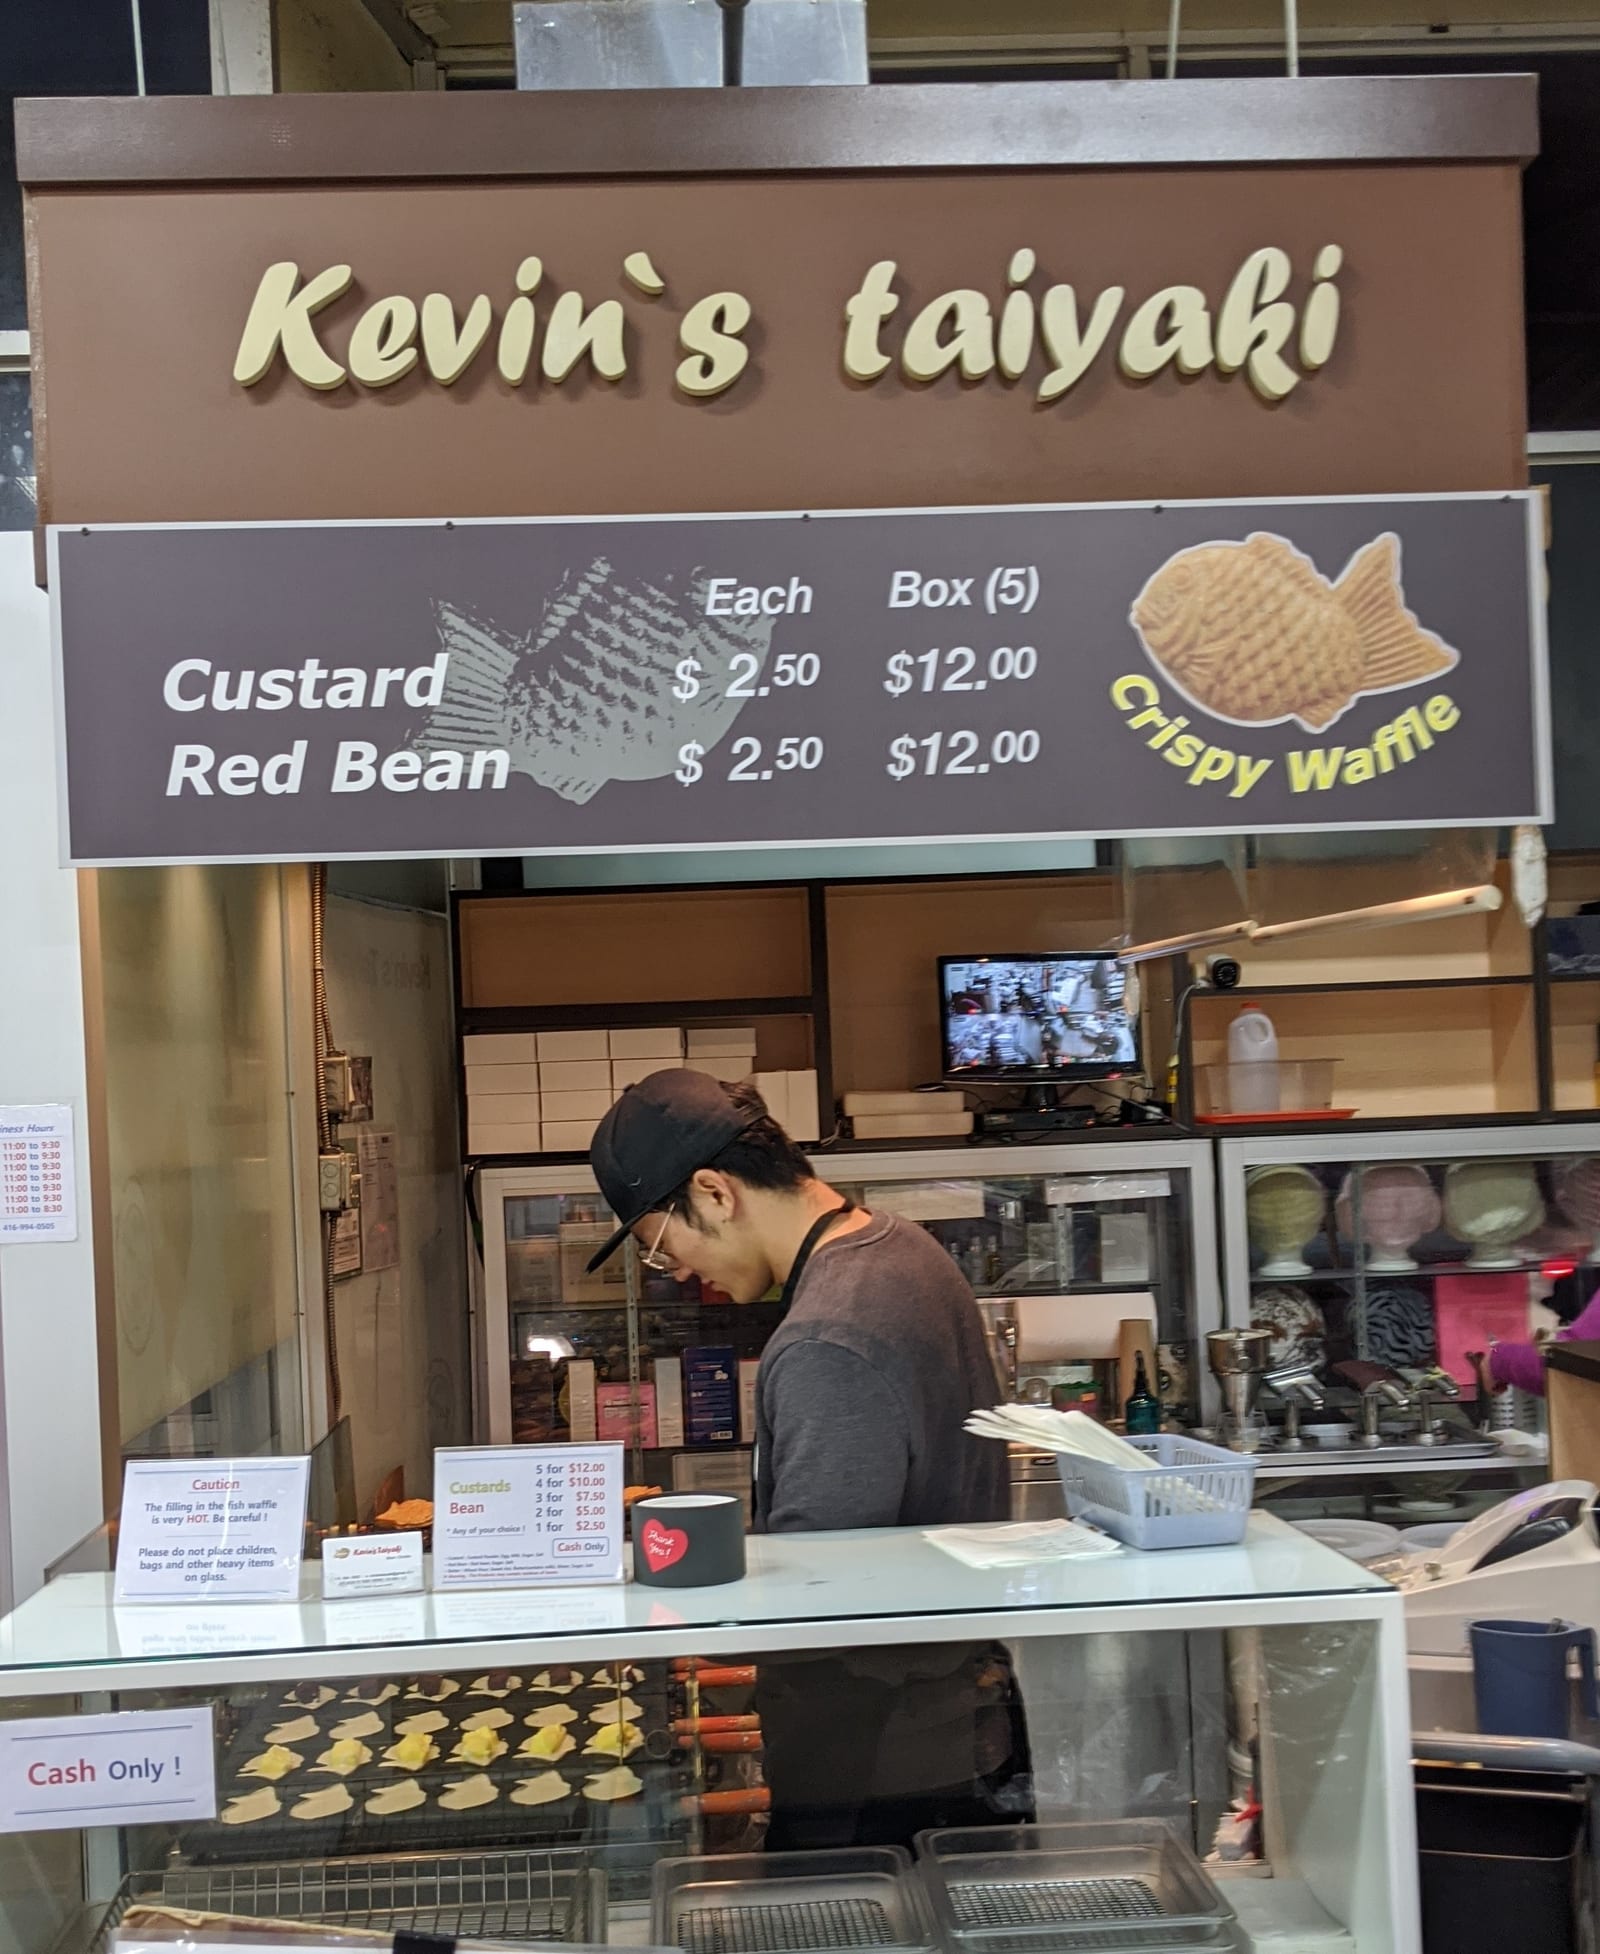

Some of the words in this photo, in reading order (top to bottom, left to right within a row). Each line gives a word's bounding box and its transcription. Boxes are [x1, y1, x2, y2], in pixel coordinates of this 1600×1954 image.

[841, 244, 1342, 401] taiyaki
[705, 576, 813, 616] Each
[888, 570, 974, 608] Box
[984, 566, 1040, 614] (5)
[883, 647, 1038, 697] $12.00
[162, 653, 450, 712] Custard
[1110, 674, 1273, 798] Crispy
[1287, 694, 1461, 793] Waffle
[886, 730, 1040, 781] $12.00
[165, 741, 308, 796] Red
[330, 740, 511, 794] Bean
[27, 1124, 54, 1132] Hours
[536, 1465, 543, 1474] 5
[547, 1464, 563, 1474] for
[569, 1462, 605, 1473] $12.00
[192, 1479, 240, 1491] Caution
[449, 1480, 511, 1494] Custards
[536, 1479, 543, 1489] 4
[547, 1478, 563, 1488] for
[569, 1477, 605, 1488] $10.00
[536, 1494, 543, 1503] 3
[547, 1493, 563, 1503] for
[576, 1491, 605, 1502] $7.50
[145, 1503, 162, 1512] The
[166, 1502, 192, 1513] filling
[196, 1502, 205, 1510] in
[208, 1501, 224, 1510] the
[228, 1500, 244, 1510] fish
[248, 1499, 277, 1509] waffle
[450, 1502, 484, 1514] Bean
[536, 1508, 543, 1517] 2
[547, 1507, 563, 1517] for
[576, 1506, 605, 1517] $5.00
[152, 1515, 159, 1524] is
[163, 1516, 184, 1526] very
[186, 1514, 209, 1524] HOT.
[213, 1514, 224, 1523] Be
[229, 1513, 261, 1522] careful
[536, 1523, 543, 1532] 1
[547, 1522, 563, 1532] for
[576, 1520, 605, 1531] $2.50
[452, 1527, 467, 1535] Any
[469, 1526, 477, 1534] of
[479, 1527, 496, 1535] your
[139, 1547, 169, 1557] Please
[172, 1547, 184, 1556] do
[188, 1546, 205, 1556] not
[208, 1546, 233, 1558] place
[558, 1542, 582, 1552] Cash
[584, 1542, 604, 1552] Only
[140, 1560, 162, 1571] bags
[166, 1559, 184, 1569] and
[187, 1559, 213, 1568] other
[217, 1558, 244, 1569] heavy
[248, 1557, 274, 1567] items
[185, 1574, 197, 1582] on
[28, 1758, 96, 1785] Cash
[108, 1758, 164, 1783] Only
